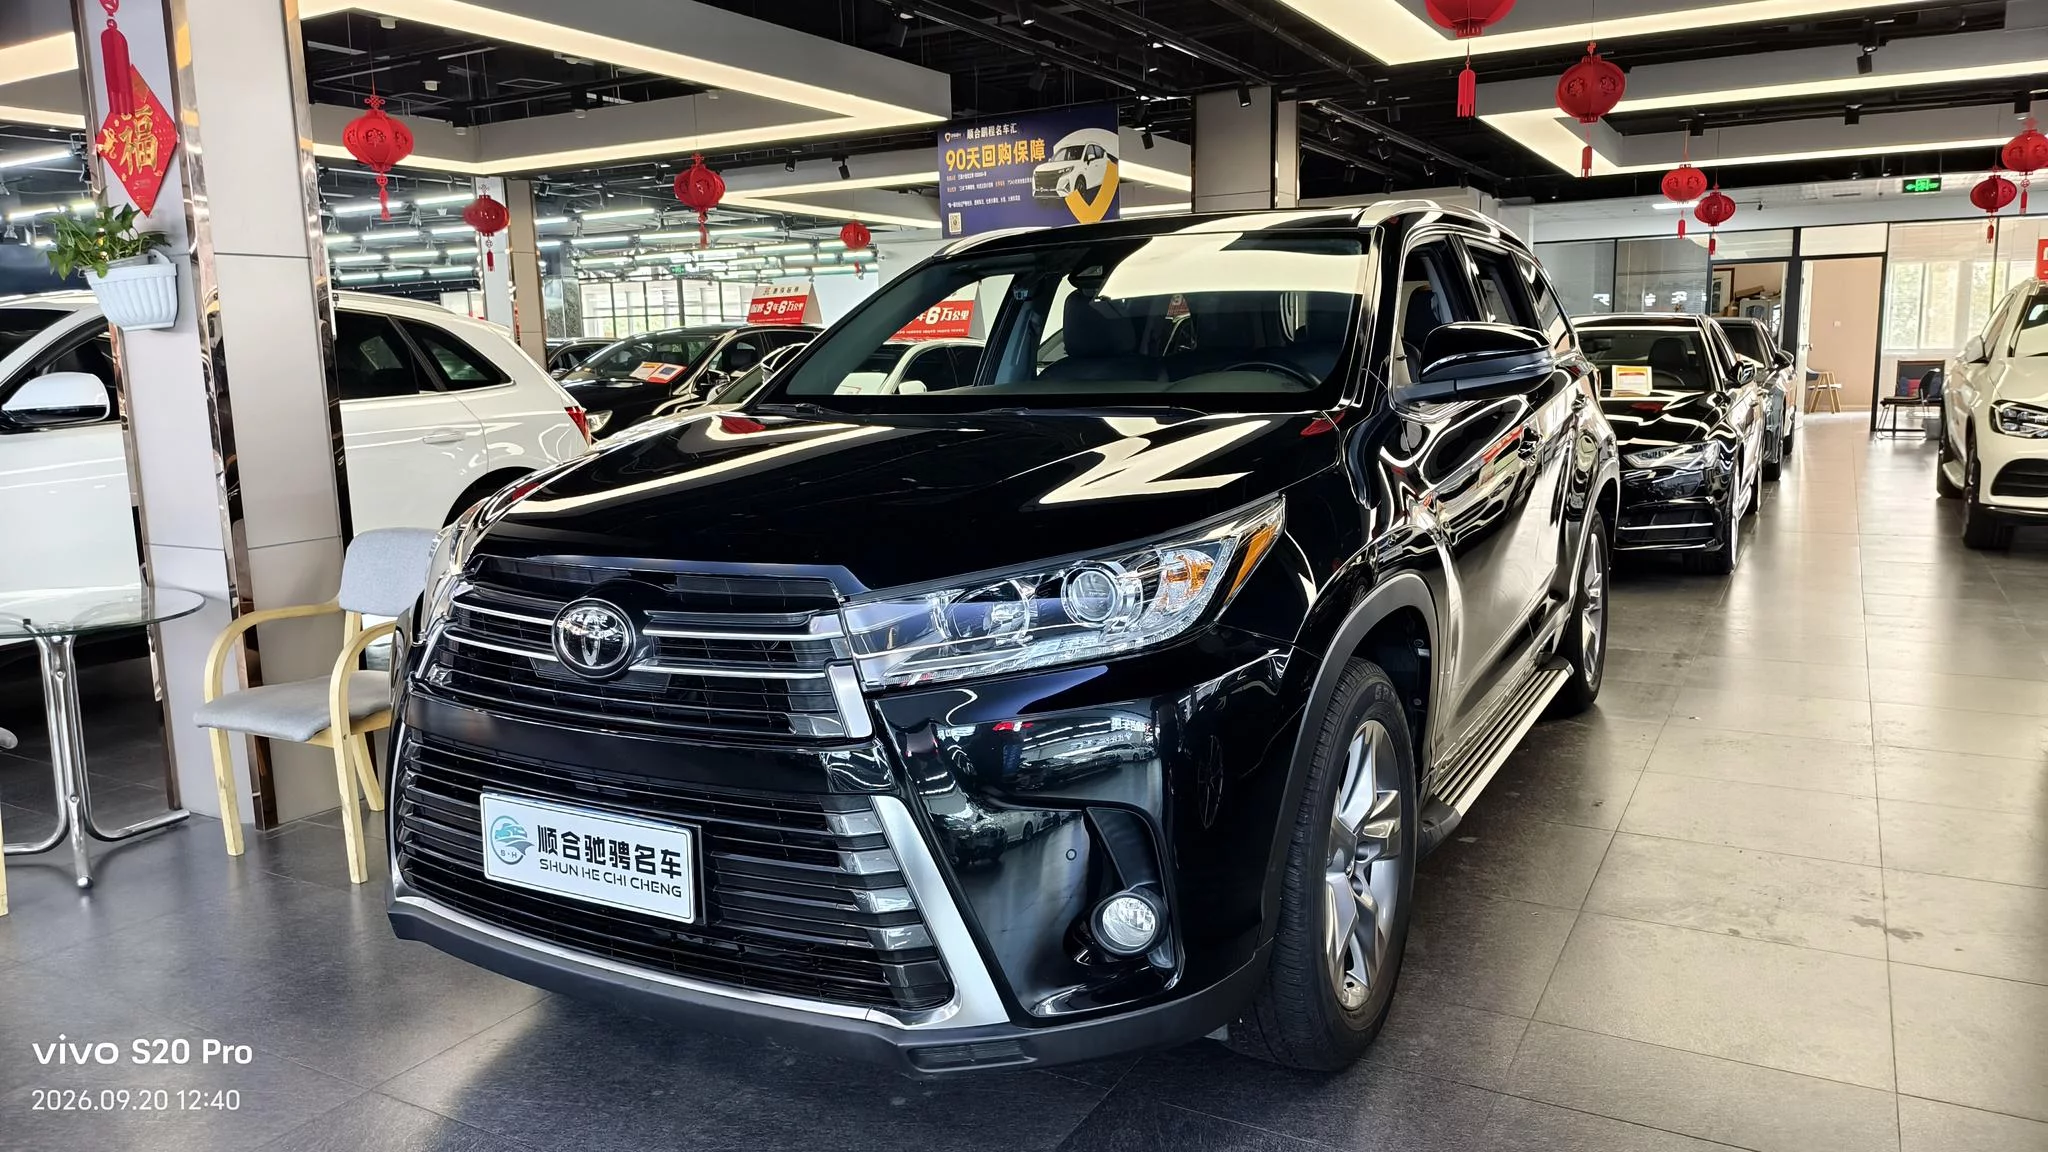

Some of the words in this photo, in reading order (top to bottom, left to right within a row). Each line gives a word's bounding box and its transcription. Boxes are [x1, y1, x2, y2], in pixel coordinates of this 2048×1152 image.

[119, 105, 159, 175] 福
[945, 138, 1046, 172] 90天回购保障
[537, 825, 682, 879] 顺合驰骋名车
[540, 858, 579, 877] SHUN
[582, 866, 600, 881] HE
[603, 871, 627, 887] CHI
[630, 877, 682, 898] CHENG
